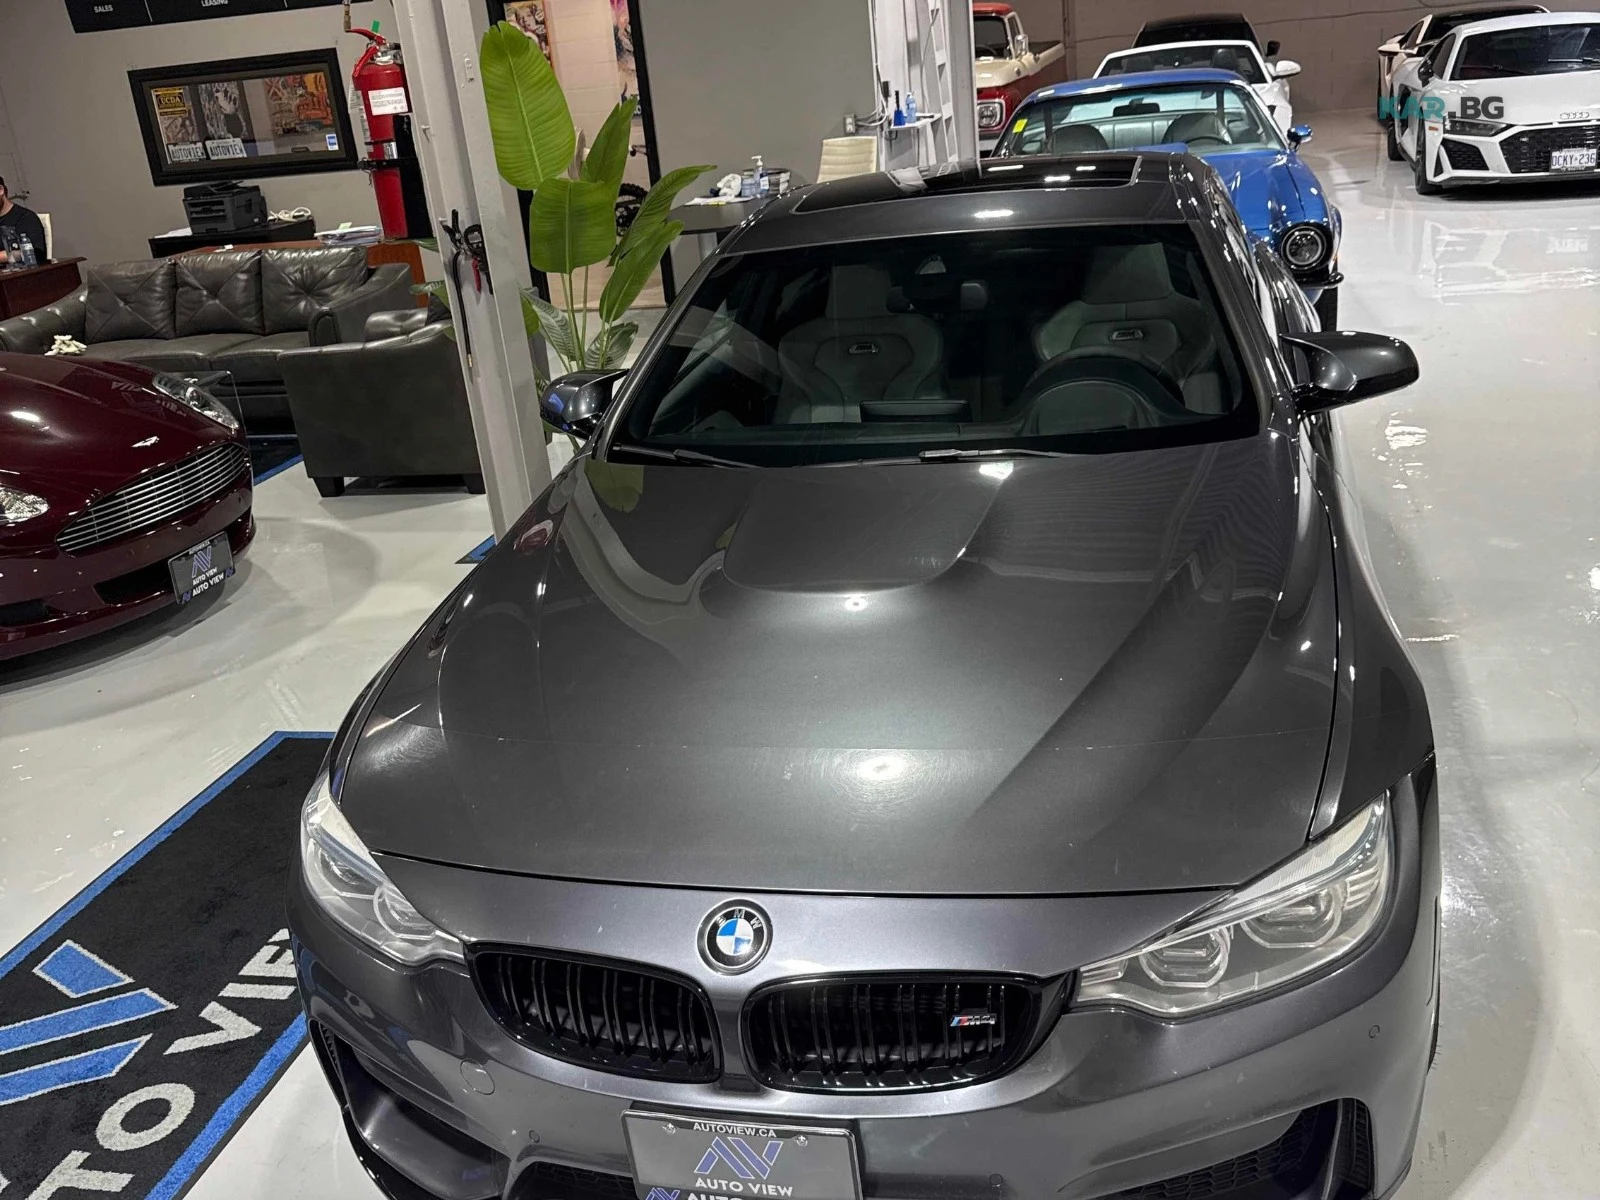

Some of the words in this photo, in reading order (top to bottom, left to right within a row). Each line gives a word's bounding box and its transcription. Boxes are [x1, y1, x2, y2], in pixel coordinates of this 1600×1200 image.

[94, 4, 113, 13] SALES
[193, 575, 206, 586] AUTO
[206, 567, 218, 578] VIEW
[193, 583, 209, 597] AUTO
[209, 573, 224, 586] VIEW
[716, 908, 763, 929] BMW
[163, 928, 298, 1056] VIE
[693, 1122, 777, 1137] AUTOVIEW.CA
[695, 1177, 744, 1192] AUTO
[748, 1182, 793, 1197] VIEW
